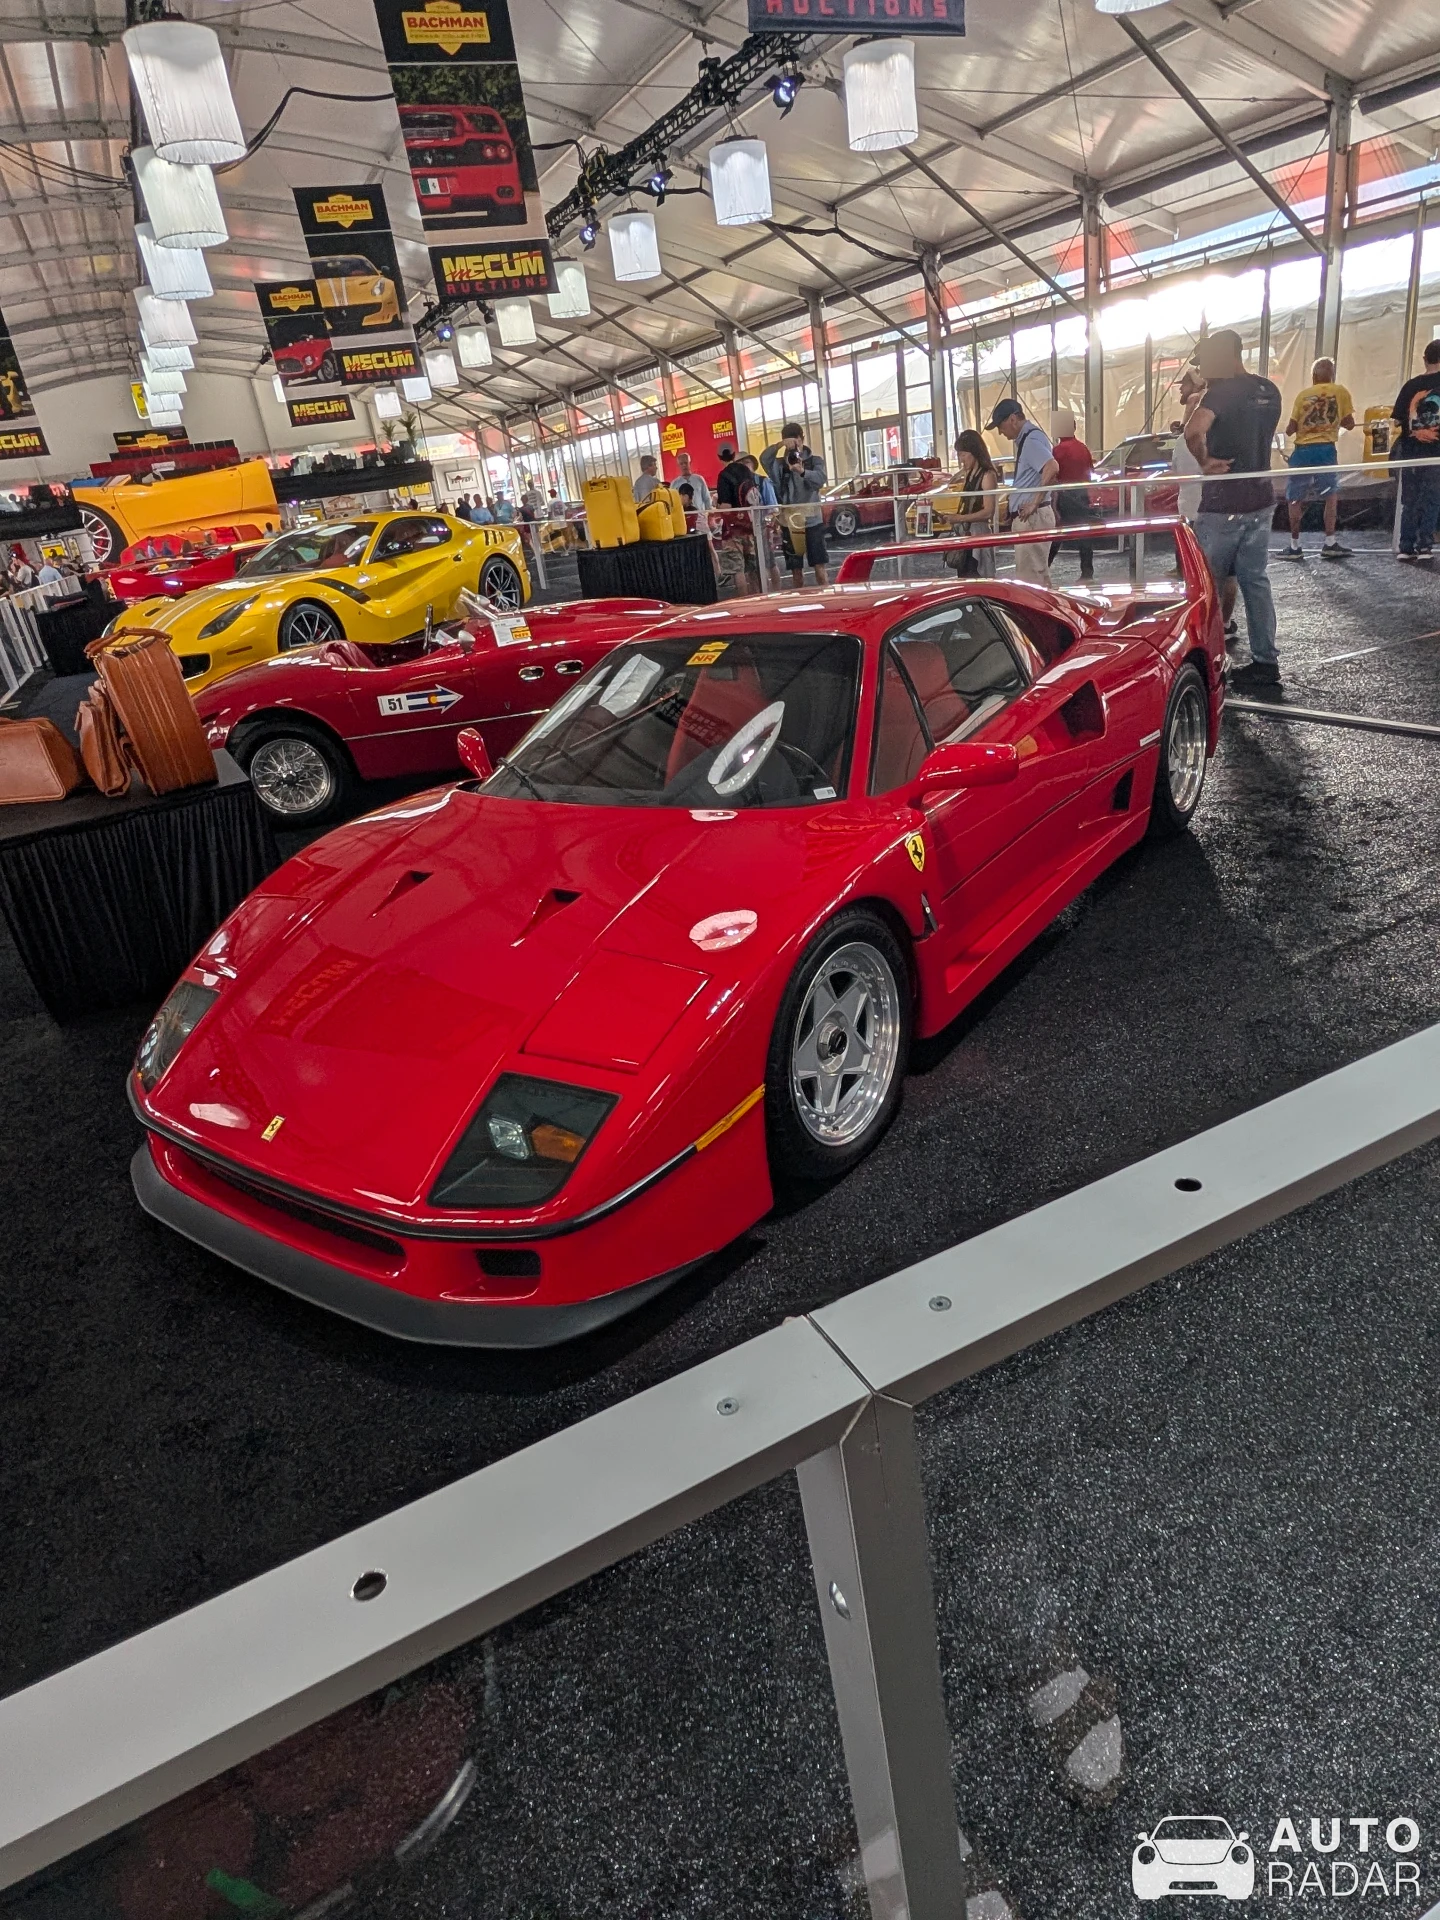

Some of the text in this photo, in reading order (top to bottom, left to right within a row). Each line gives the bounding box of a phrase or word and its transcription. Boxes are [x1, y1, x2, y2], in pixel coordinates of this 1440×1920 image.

[406, 17, 485, 28] BACHMAN
[316, 203, 369, 213] BACHMAN
[441, 250, 546, 282] MECUM
[446, 276, 549, 295] AUCTIONS
[272, 293, 312, 302] BACHMAN
[342, 350, 415, 372] MECUM
[345, 366, 417, 380] AUCTIONS
[292, 399, 348, 417] MECUM
[0, 433, 40, 449] CUM
[387, 697, 403, 711] 51
